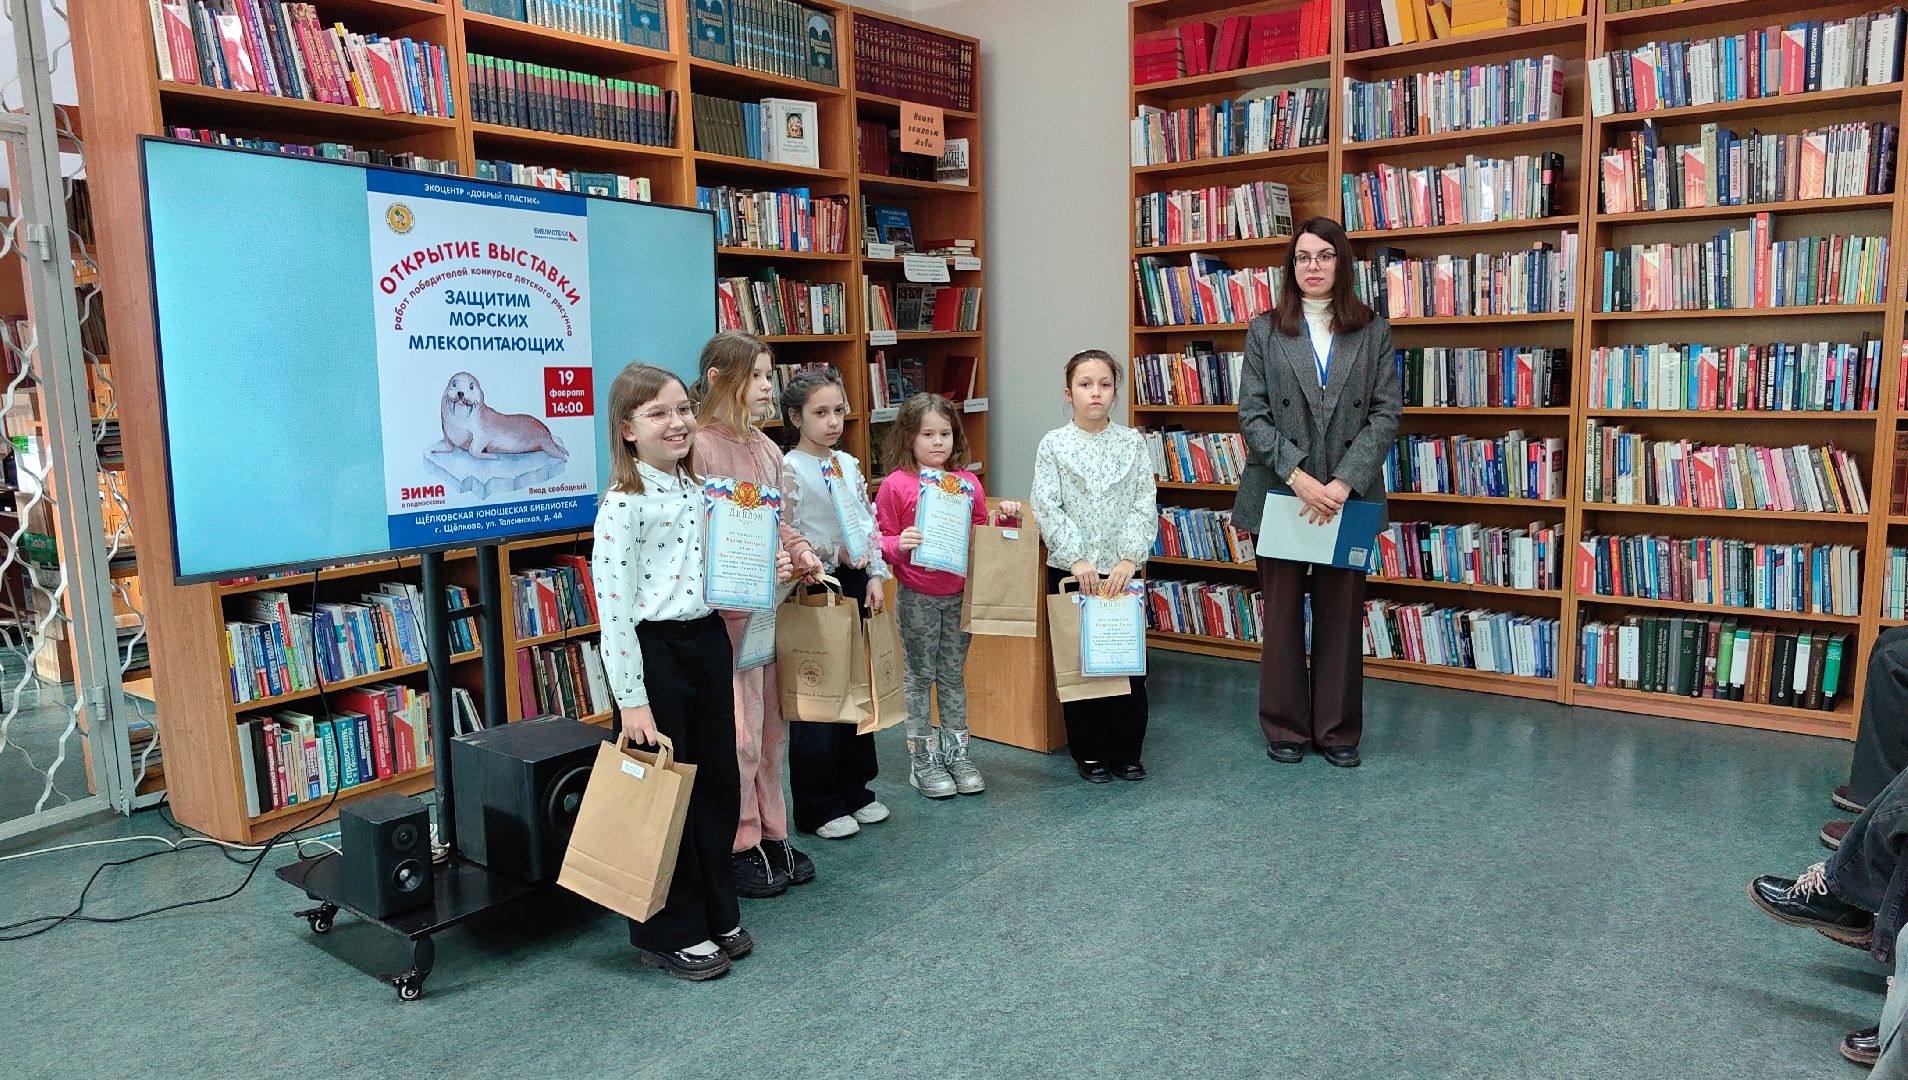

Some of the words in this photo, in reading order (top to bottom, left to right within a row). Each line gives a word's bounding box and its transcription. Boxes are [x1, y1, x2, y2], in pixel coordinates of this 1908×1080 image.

[424, 183, 464, 196] ЭКОЦЕНТР
[467, 189, 502, 200] «ДОБРЫЙ
[504, 194, 540, 205] ПЛАСТИК»
[380, 241, 480, 295] ОТКРЫТИЕ
[488, 242, 581, 306] ВЫСТАВКИ
[395, 298, 410, 331] работ
[409, 267, 468, 298] победителей
[471, 269, 512, 279] конкурса
[514, 273, 552, 299] детского
[551, 297, 573, 337] рисунка
[445, 289, 531, 309] ЗАЩИТИМ
[449, 312, 528, 328] МОРСКИХ
[408, 335, 564, 355] МЛЕКОПИТАЮЩИХ
[558, 370, 574, 385] 19
[549, 387, 585, 398] февраля
[552, 401, 583, 414] 14:00
[401, 484, 445, 500] ЗИМА
[529, 487, 546, 495] Вход
[548, 482, 587, 493] свободный
[415, 511, 474, 525] ЩЁЛКОВСКАЯ
[476, 505, 528, 519] ЮНОШЕСКАЯ
[530, 499, 578, 512] БИБЛИОТЕКА
[728, 508, 763, 521] ДИПЛОМ
[443, 521, 484, 534] Щёлково,
[486, 520, 496, 529] ул.
[499, 515, 542, 526] Талсинская,
[340, 728, 353, 785] Справочник
